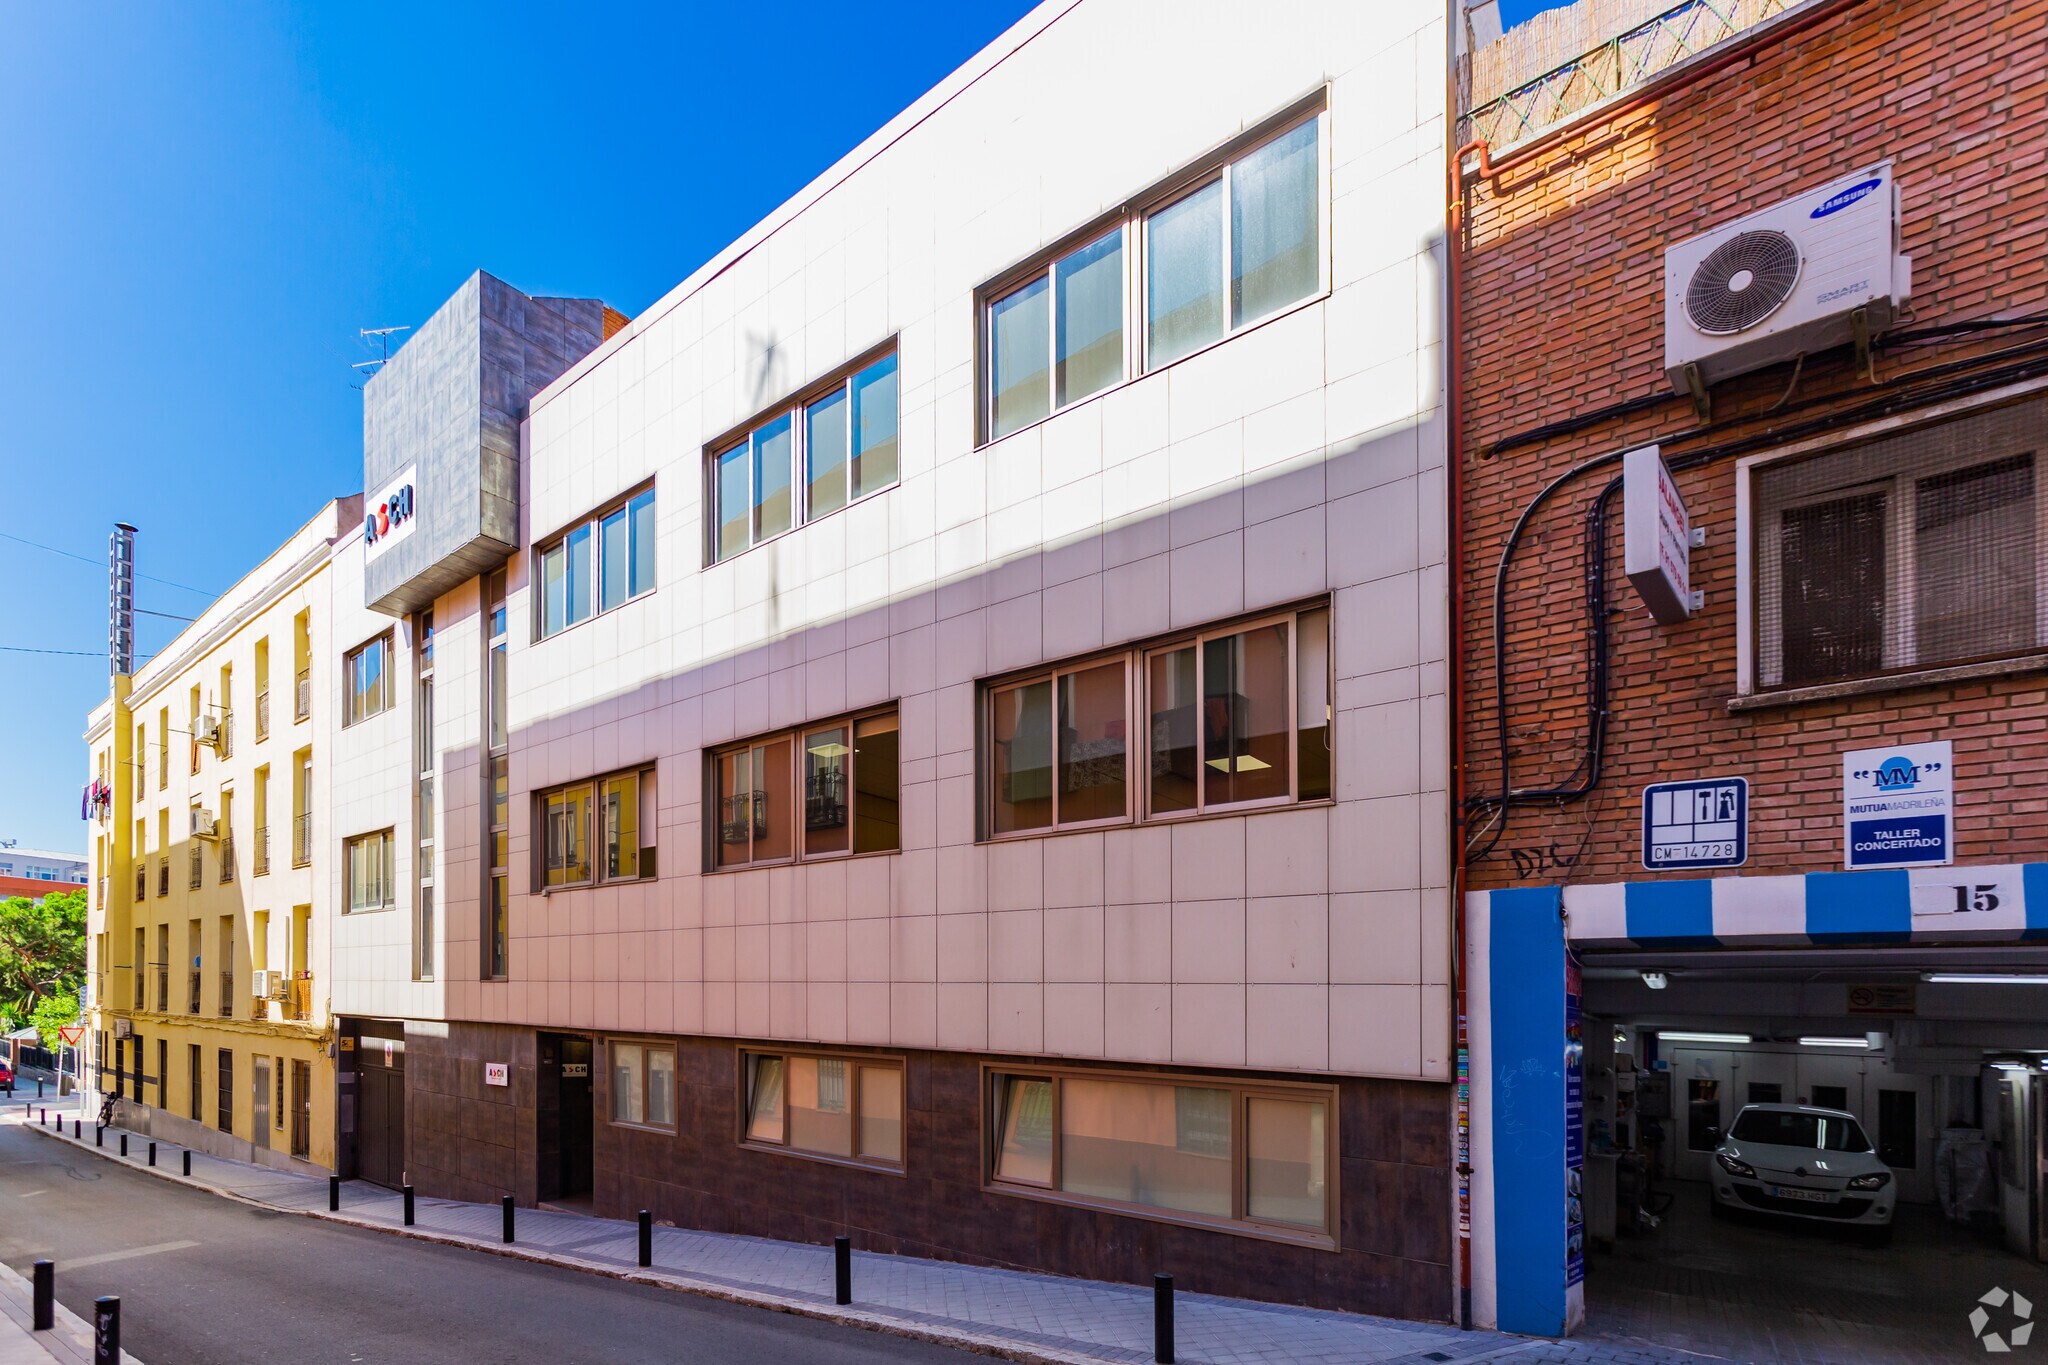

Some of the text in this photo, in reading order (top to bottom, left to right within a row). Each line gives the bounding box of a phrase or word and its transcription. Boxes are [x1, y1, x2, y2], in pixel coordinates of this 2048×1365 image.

[1818, 186, 1873, 212] SAMSUNG
[1816, 279, 1870, 299] SMART
[364, 484, 413, 546] ASCH
[1850, 797, 1945, 814] MUTUAMADRILEÑA
[1873, 828, 1921, 840] TALLER
[1854, 837, 1942, 852] CONCERTADO
[1952, 884, 1999, 913] 15
